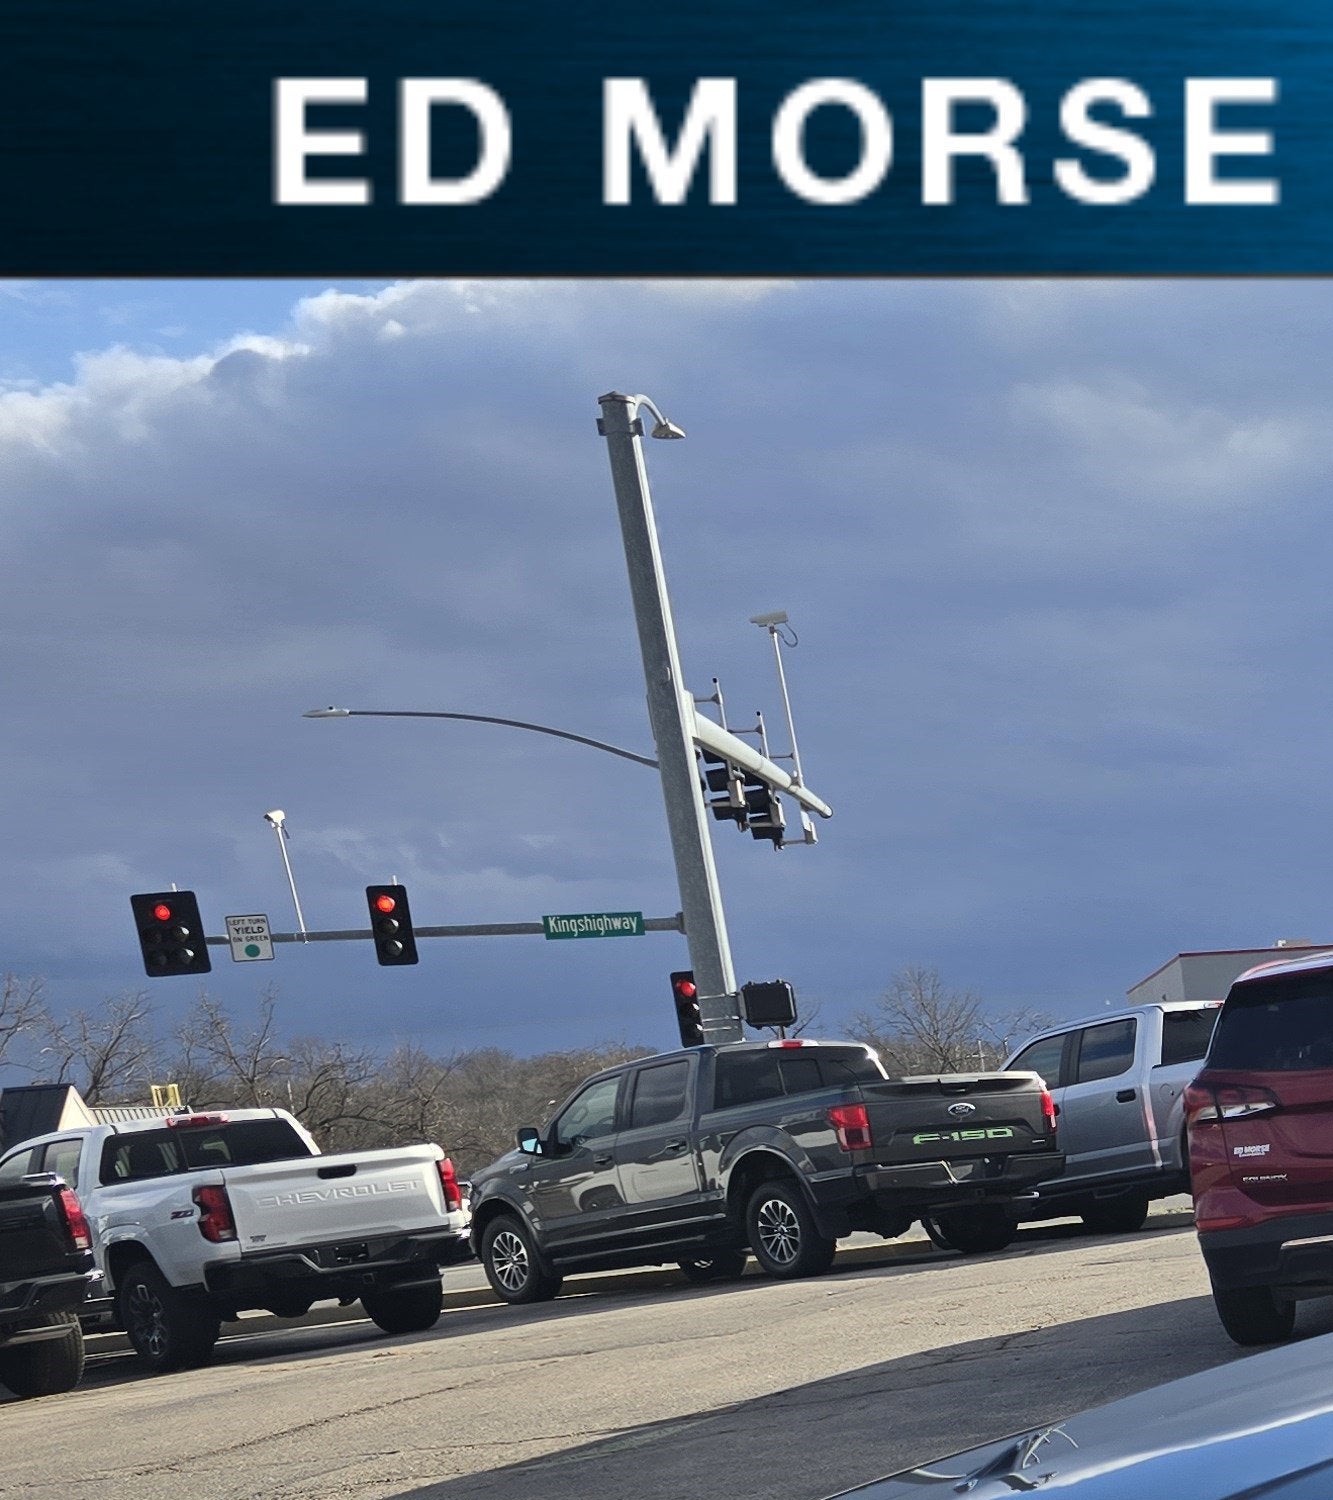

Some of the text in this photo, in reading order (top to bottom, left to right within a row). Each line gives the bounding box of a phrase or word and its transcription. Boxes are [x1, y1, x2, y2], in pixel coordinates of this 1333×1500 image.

[233, 926, 265, 934] YIELD
[548, 915, 638, 937] Kingshighway
[912, 1127, 1014, 1145] F-150
[257, 1180, 422, 1208] CHEVROLET
